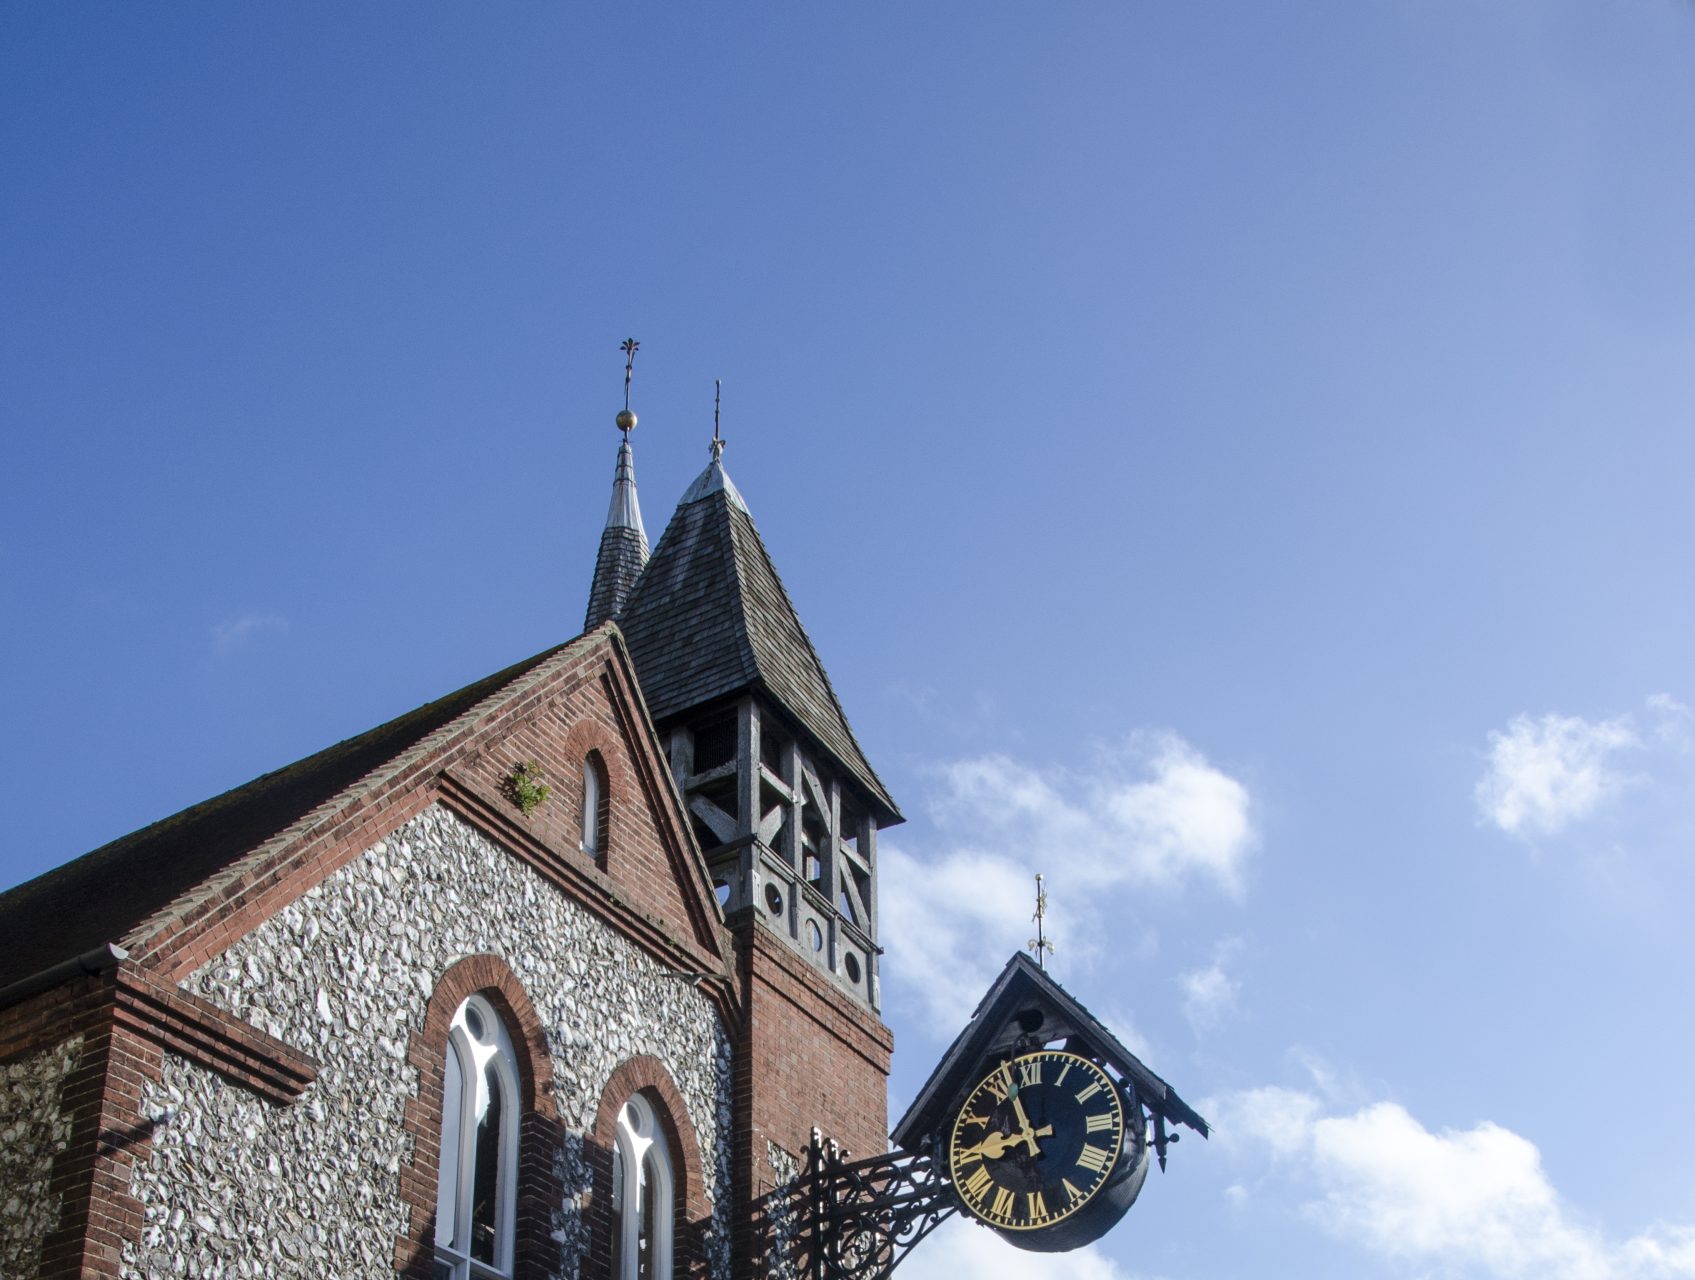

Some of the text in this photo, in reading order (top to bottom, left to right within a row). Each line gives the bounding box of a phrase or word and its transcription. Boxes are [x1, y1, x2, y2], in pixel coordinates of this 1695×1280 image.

[1019, 1061, 1042, 1088] XII
[1054, 1063, 1072, 1086] I
[1074, 1080, 1102, 1104] II
[966, 1111, 990, 1130] X
[1085, 1111, 1113, 1134] III
[1075, 1142, 1109, 1173] IIII
[964, 1164, 994, 1203] VIII
[1061, 1177, 1083, 1203] V
[991, 1186, 1015, 1219] VII
[1026, 1190, 1049, 1219] VI
